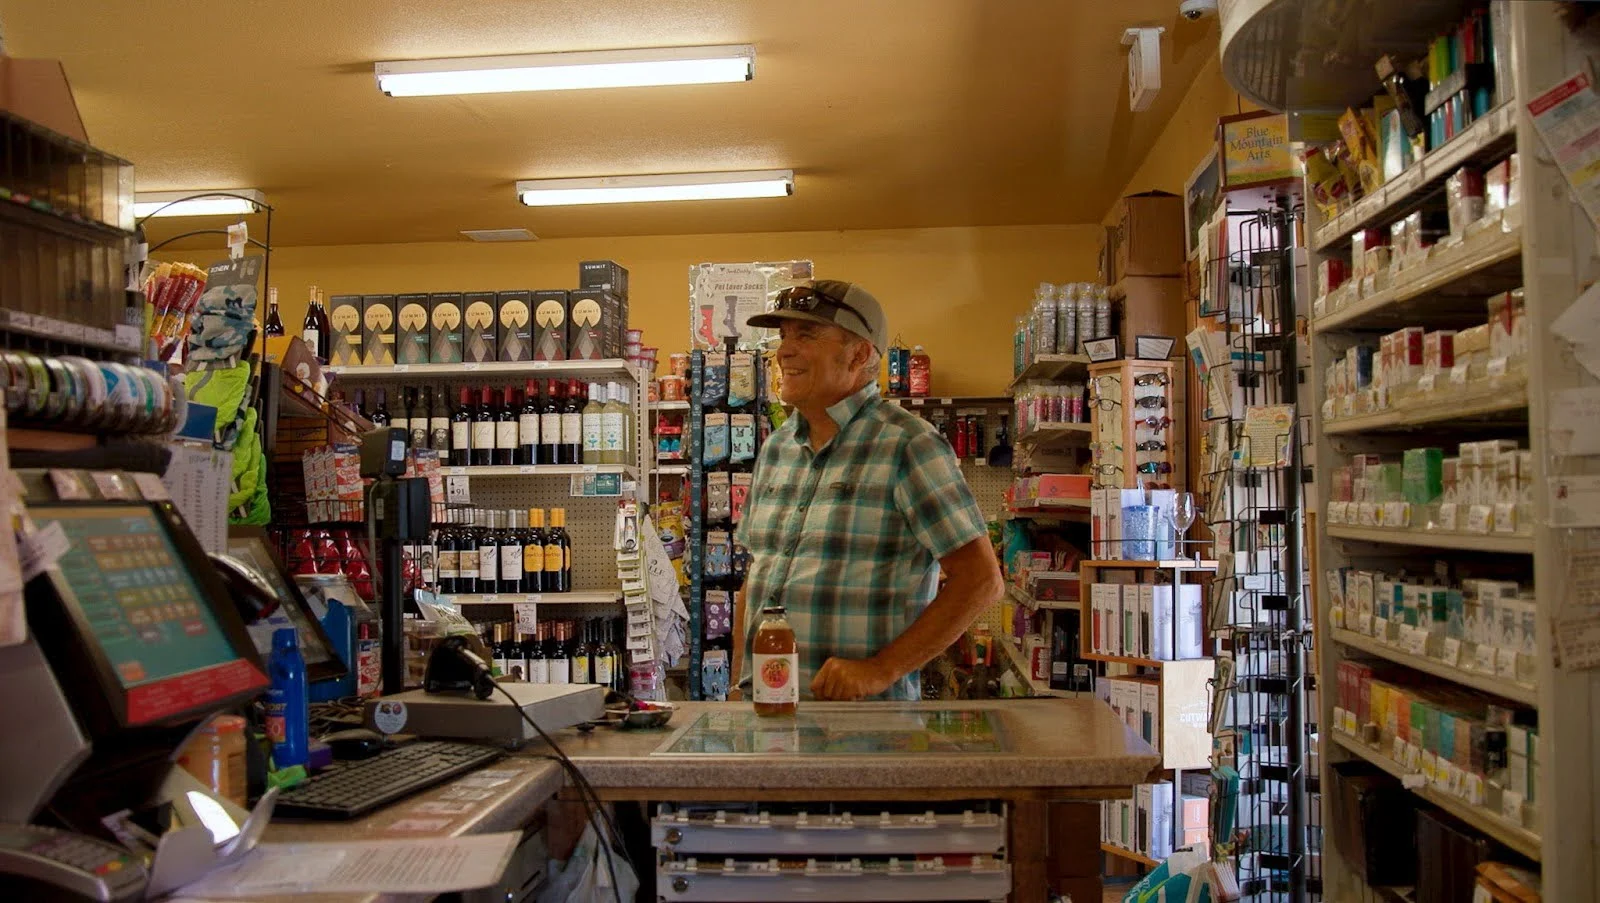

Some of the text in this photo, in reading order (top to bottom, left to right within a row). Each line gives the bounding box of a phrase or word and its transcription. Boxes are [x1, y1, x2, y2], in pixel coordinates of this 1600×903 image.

[1246, 126, 1269, 138] Blue
[1230, 135, 1283, 152] Mountain
[1247, 150, 1271, 161] Arts
[456, 488, 465, 496] 91
[520, 616, 530, 624] 92
